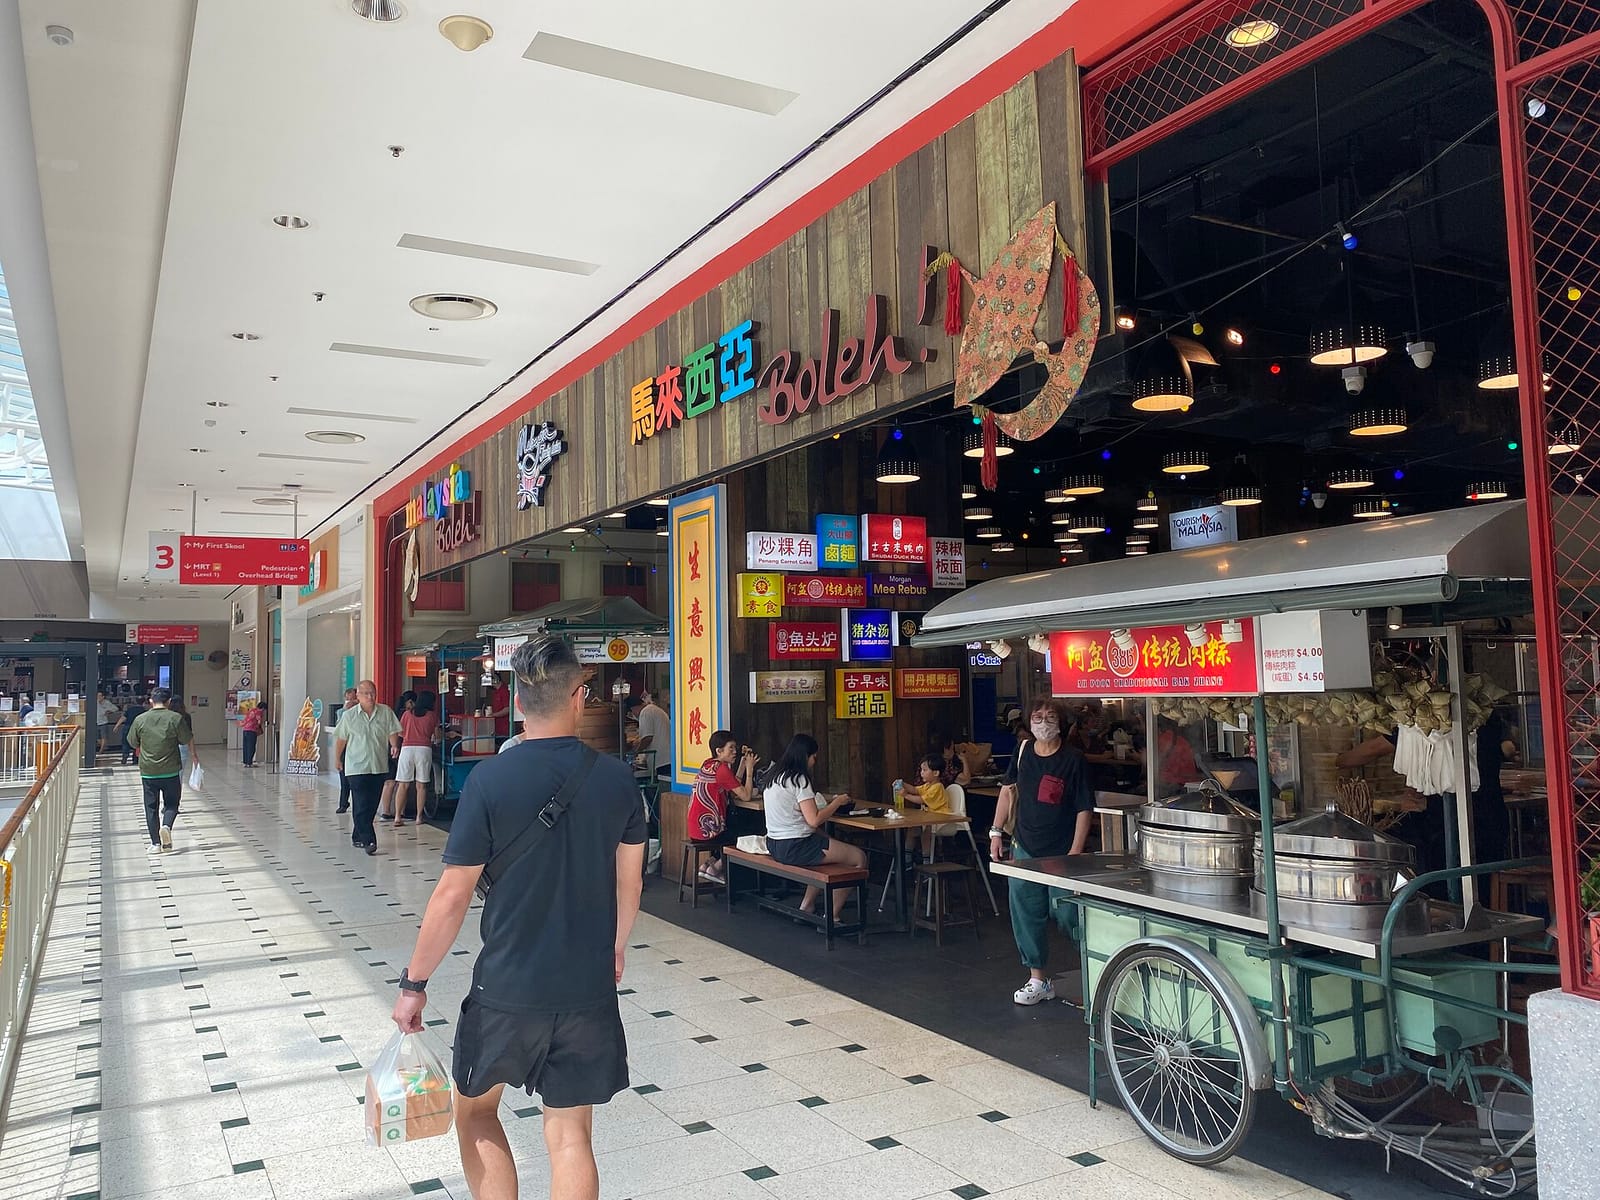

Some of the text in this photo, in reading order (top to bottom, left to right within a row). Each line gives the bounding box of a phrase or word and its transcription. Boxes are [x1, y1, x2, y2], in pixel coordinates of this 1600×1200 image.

[631, 319, 757, 445] 馬來西亞
[406, 463, 470, 529] malaysia
[1172, 516, 1202, 528] TOURISM
[1178, 521, 1223, 538] MALAYSIA
[193, 542, 204, 550] My
[758, 536, 812, 558] 炒粿角
[936, 542, 962, 556] 辣椒
[155, 545, 174, 570] 3
[936, 559, 962, 574] 板面
[274, 572, 298, 581] Bridge
[873, 584, 927, 595] Mee Rebus
[746, 600, 777, 614] 素食
[129, 630, 136, 639] 3
[852, 623, 889, 638] 猪杂汤
[687, 540, 708, 745] 生意興隆
[789, 631, 837, 647] 魚头炉
[611, 643, 626, 656] 98
[1067, 640, 1106, 672] 阿盆
[1296, 647, 1323, 658] $4.00
[1111, 648, 1134, 668] 386
[845, 675, 888, 688] 古早味
[1077, 676, 1224, 688] AH POON TRADITIONAL BAK ZHANG
[1298, 672, 1325, 682] $4.50
[848, 693, 887, 715] 甜品
